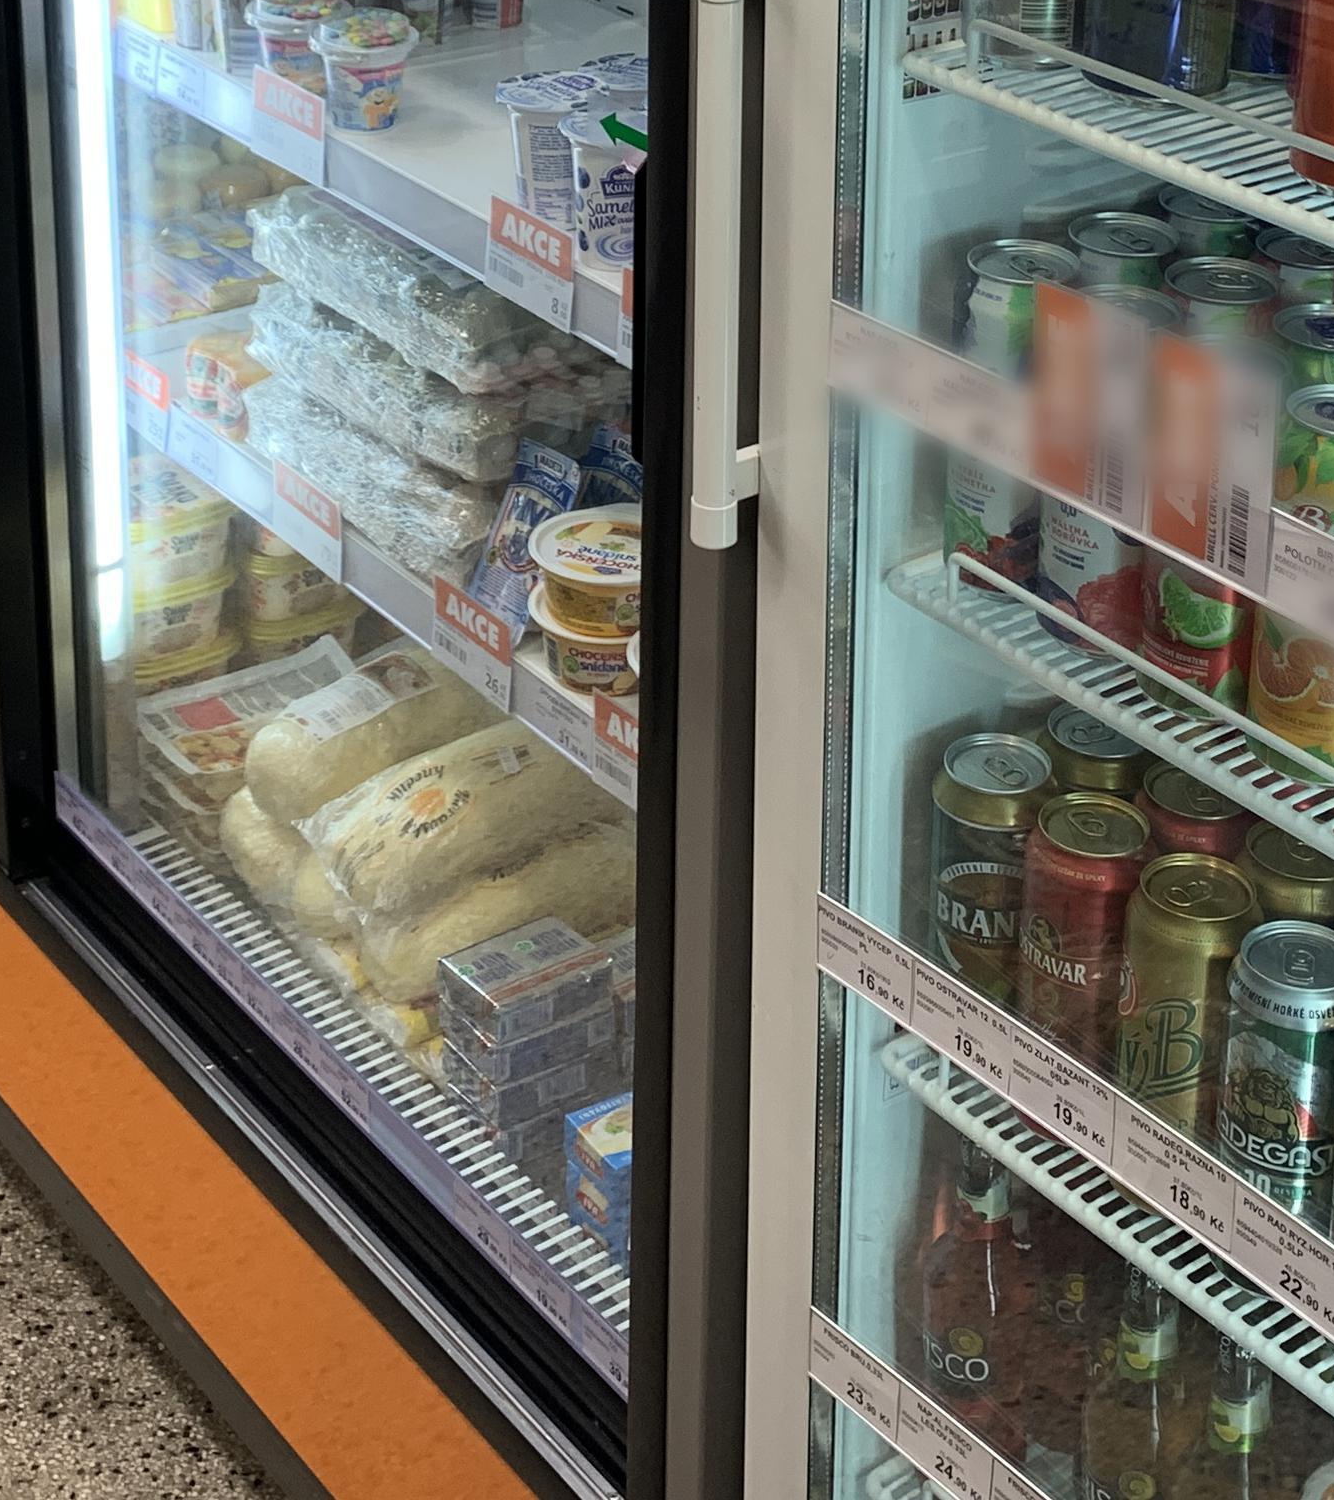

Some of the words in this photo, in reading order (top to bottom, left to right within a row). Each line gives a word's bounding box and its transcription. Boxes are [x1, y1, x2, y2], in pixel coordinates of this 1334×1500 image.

[263, 78, 317, 134] AKCE
[500, 212, 562, 268] AKCE
[445, 592, 501, 651] AKCE
[836, 915, 866, 943] BRANIK
[857, 968, 890, 1001] 16,90
[892, 994, 906, 1011] Kč
[916, 967, 936, 987] PIVO
[936, 979, 980, 1017] OSTRAVAR
[979, 1009, 990, 1024] 12
[953, 1033, 988, 1069] 19,90
[989, 1063, 1004, 1081] Kč
[1013, 1034, 1034, 1055] PIVO
[1052, 1101, 1089, 1139] 19,90
[1091, 1131, 1107, 1149] Kč
[1130, 1113, 1152, 1136] PIVO
[1216, 1169, 1228, 1184] 10
[1168, 1183, 1206, 1221] 18,90
[1209, 1214, 1226, 1234] Kč
[1242, 1196, 1266, 1219] PIVO
[1278, 1268, 1320, 1312] 22,90
[922, 1334, 990, 1382] ISCO
